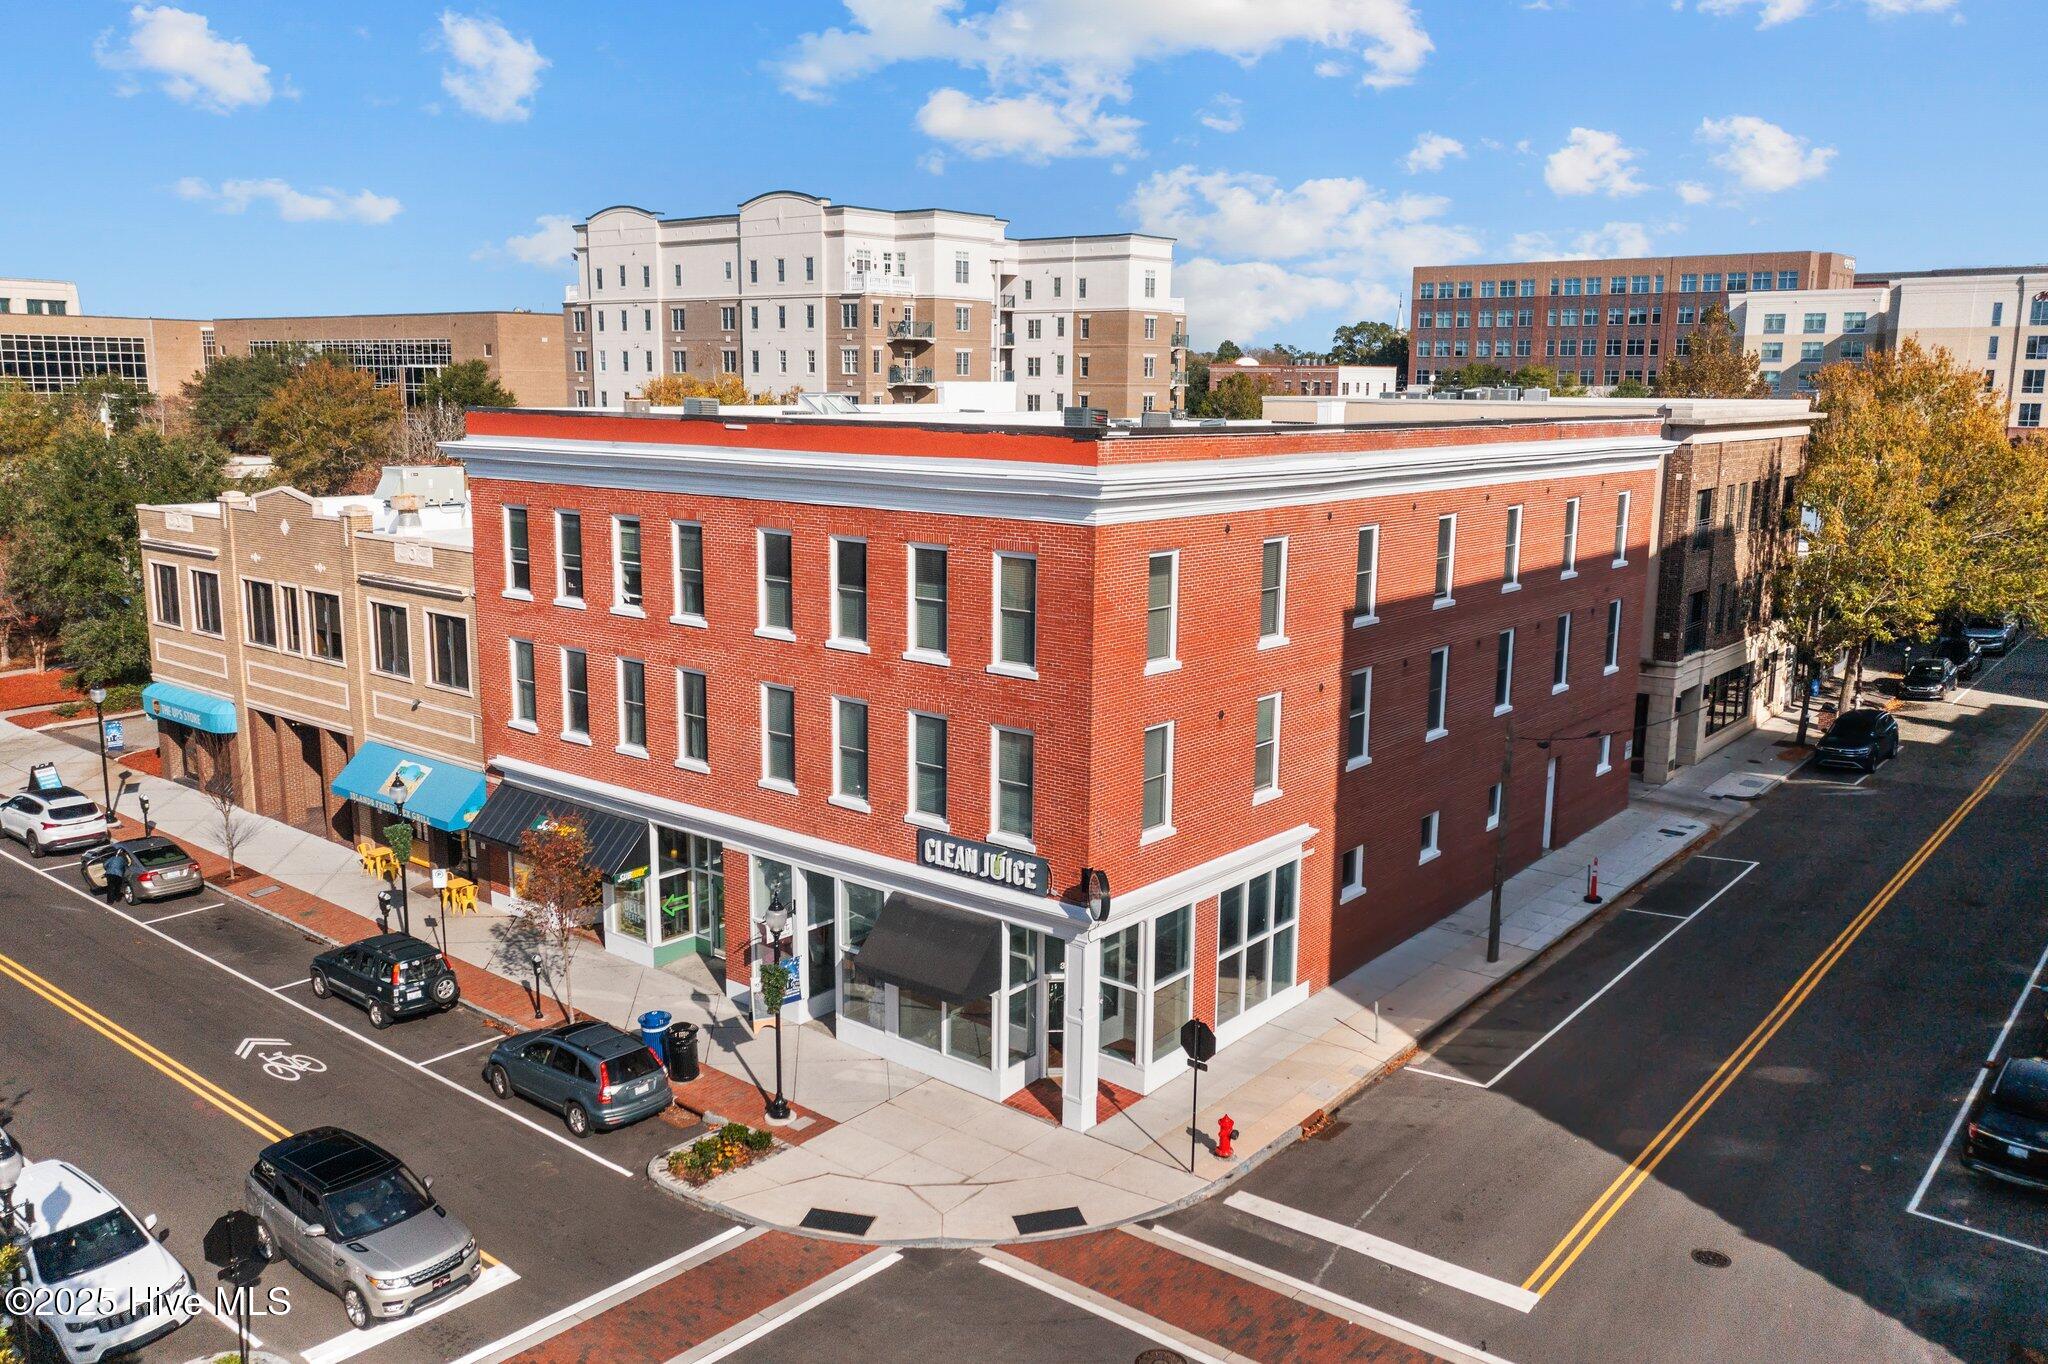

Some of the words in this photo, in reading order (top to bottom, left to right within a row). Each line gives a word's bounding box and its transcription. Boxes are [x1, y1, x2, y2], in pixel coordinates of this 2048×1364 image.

[161, 703, 171, 716] THE
[171, 706, 183, 720] UPS
[183, 710, 201, 725] STORE
[924, 838, 978, 874] CLEAN
[980, 851, 1037, 889] JUICE
